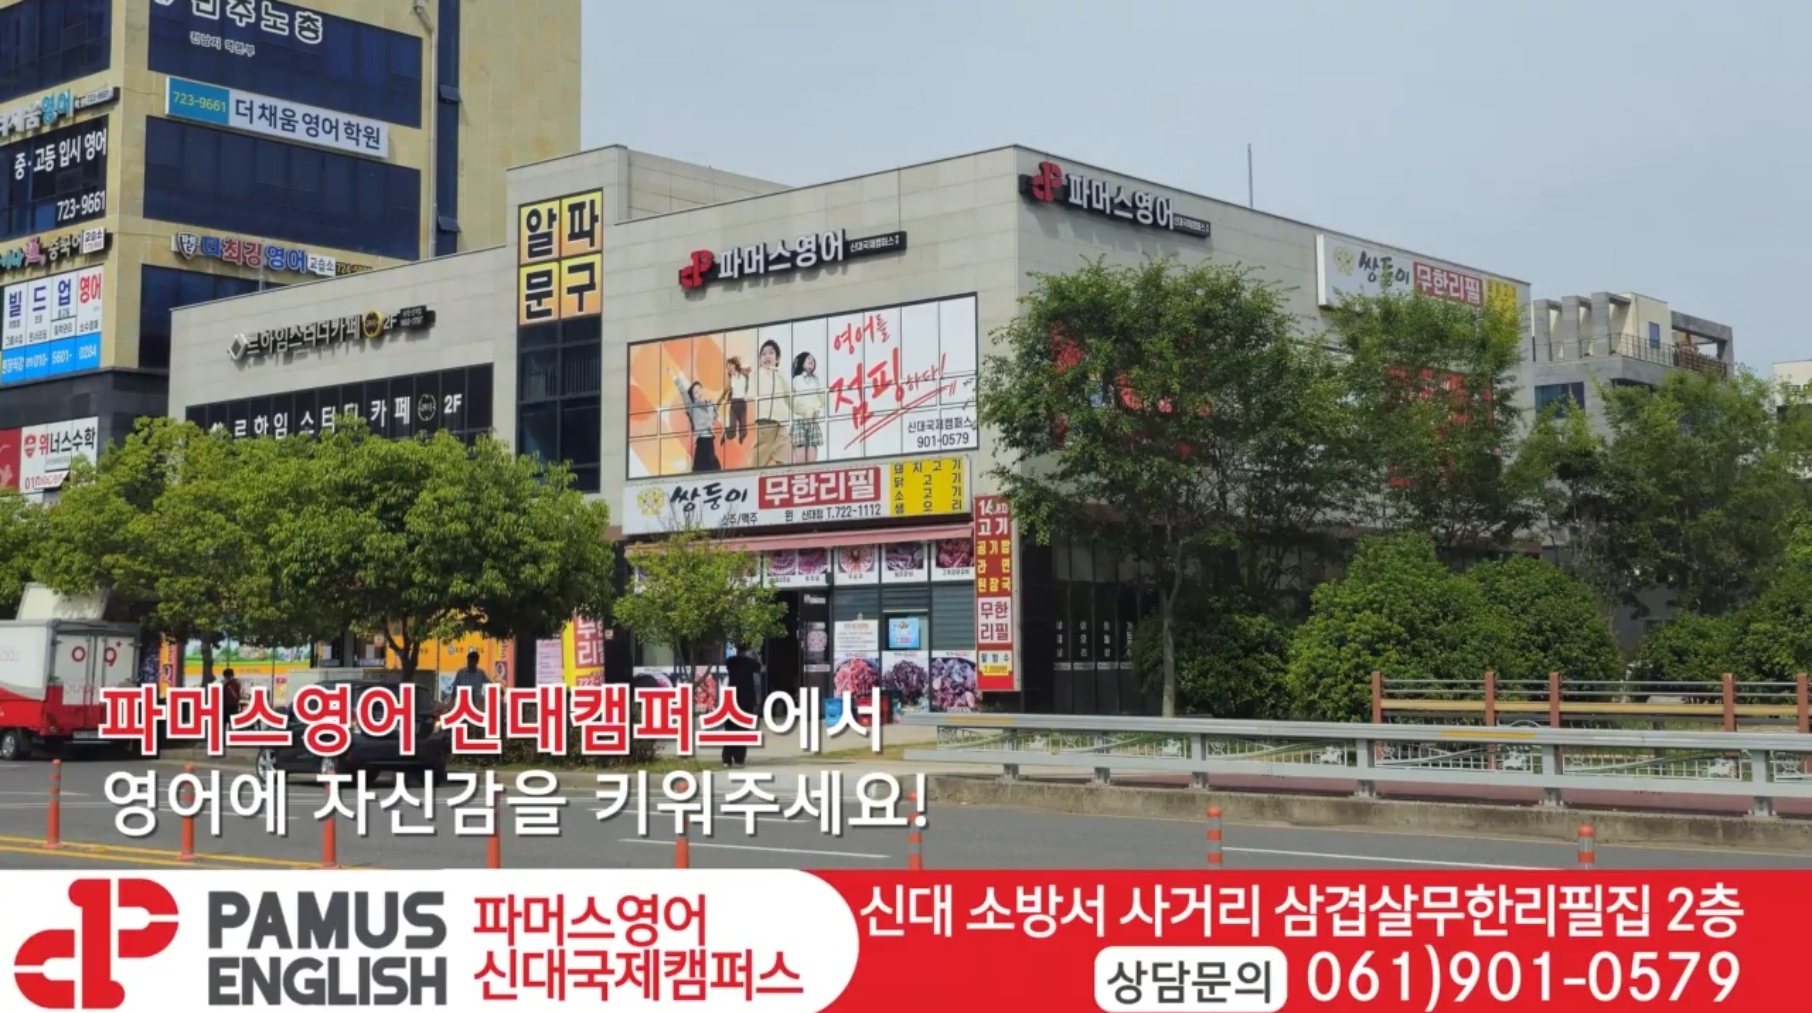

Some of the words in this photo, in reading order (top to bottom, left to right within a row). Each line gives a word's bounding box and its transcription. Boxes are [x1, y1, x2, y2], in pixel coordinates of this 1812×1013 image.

[173, 91, 226, 113] 723-9661
[59, 135, 81, 168] 입시
[84, 128, 107, 160] 영어
[57, 190, 105, 221] 723-9661
[1068, 174, 1173, 230] 파머스영어
[717, 228, 844, 279] 파머스영어
[1416, 263, 1480, 303] 무한리필
[833, 313, 890, 355] 영어를
[370, 395, 410, 426] 카페
[444, 394, 462, 414] 2F
[907, 416, 973, 434] 신대국제캠퍼스
[39, 426, 95, 455] 위너스수학
[917, 432, 970, 449] 901-0579
[670, 481, 748, 512] 쌍둥이
[764, 468, 875, 506] 무한리필
[978, 516, 1008, 535] 고기
[981, 601, 1009, 619] 무한
[981, 623, 1008, 641] 리필
